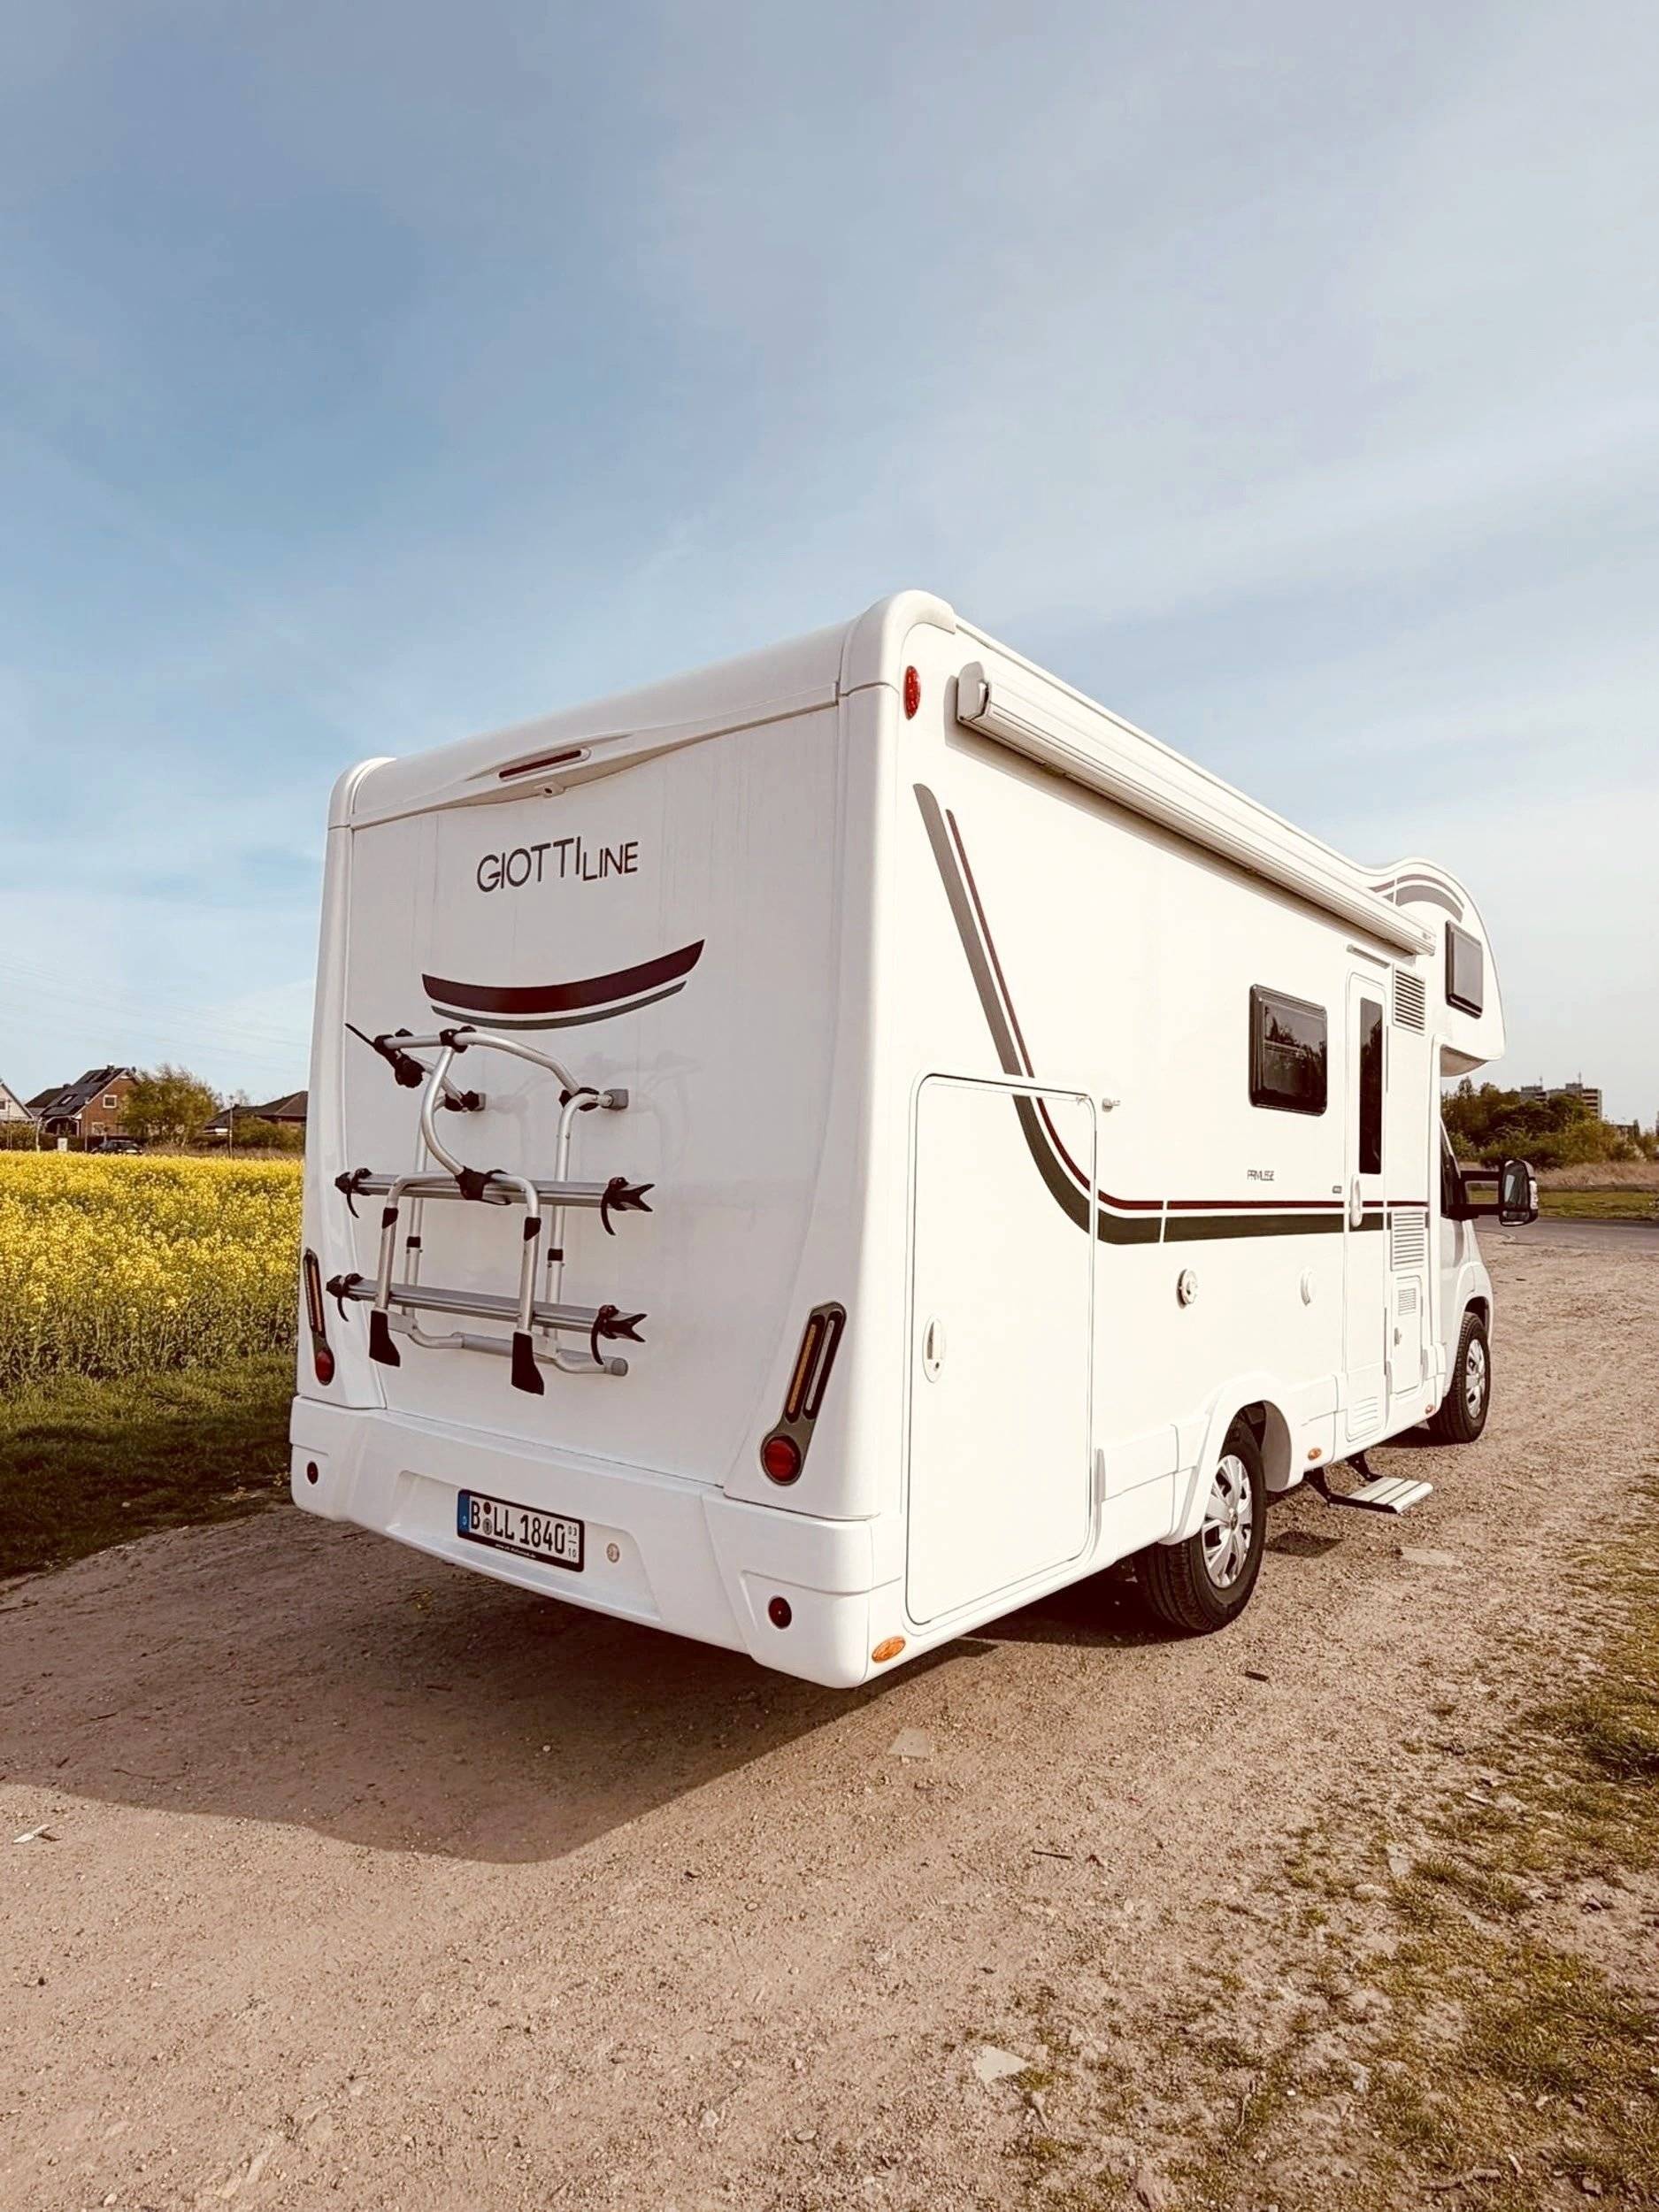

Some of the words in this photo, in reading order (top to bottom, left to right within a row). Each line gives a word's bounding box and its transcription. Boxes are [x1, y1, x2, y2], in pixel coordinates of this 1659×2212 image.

[471, 1501, 480, 1530] B
[494, 1507, 514, 1540] LL
[519, 1515, 565, 1555] 1840
